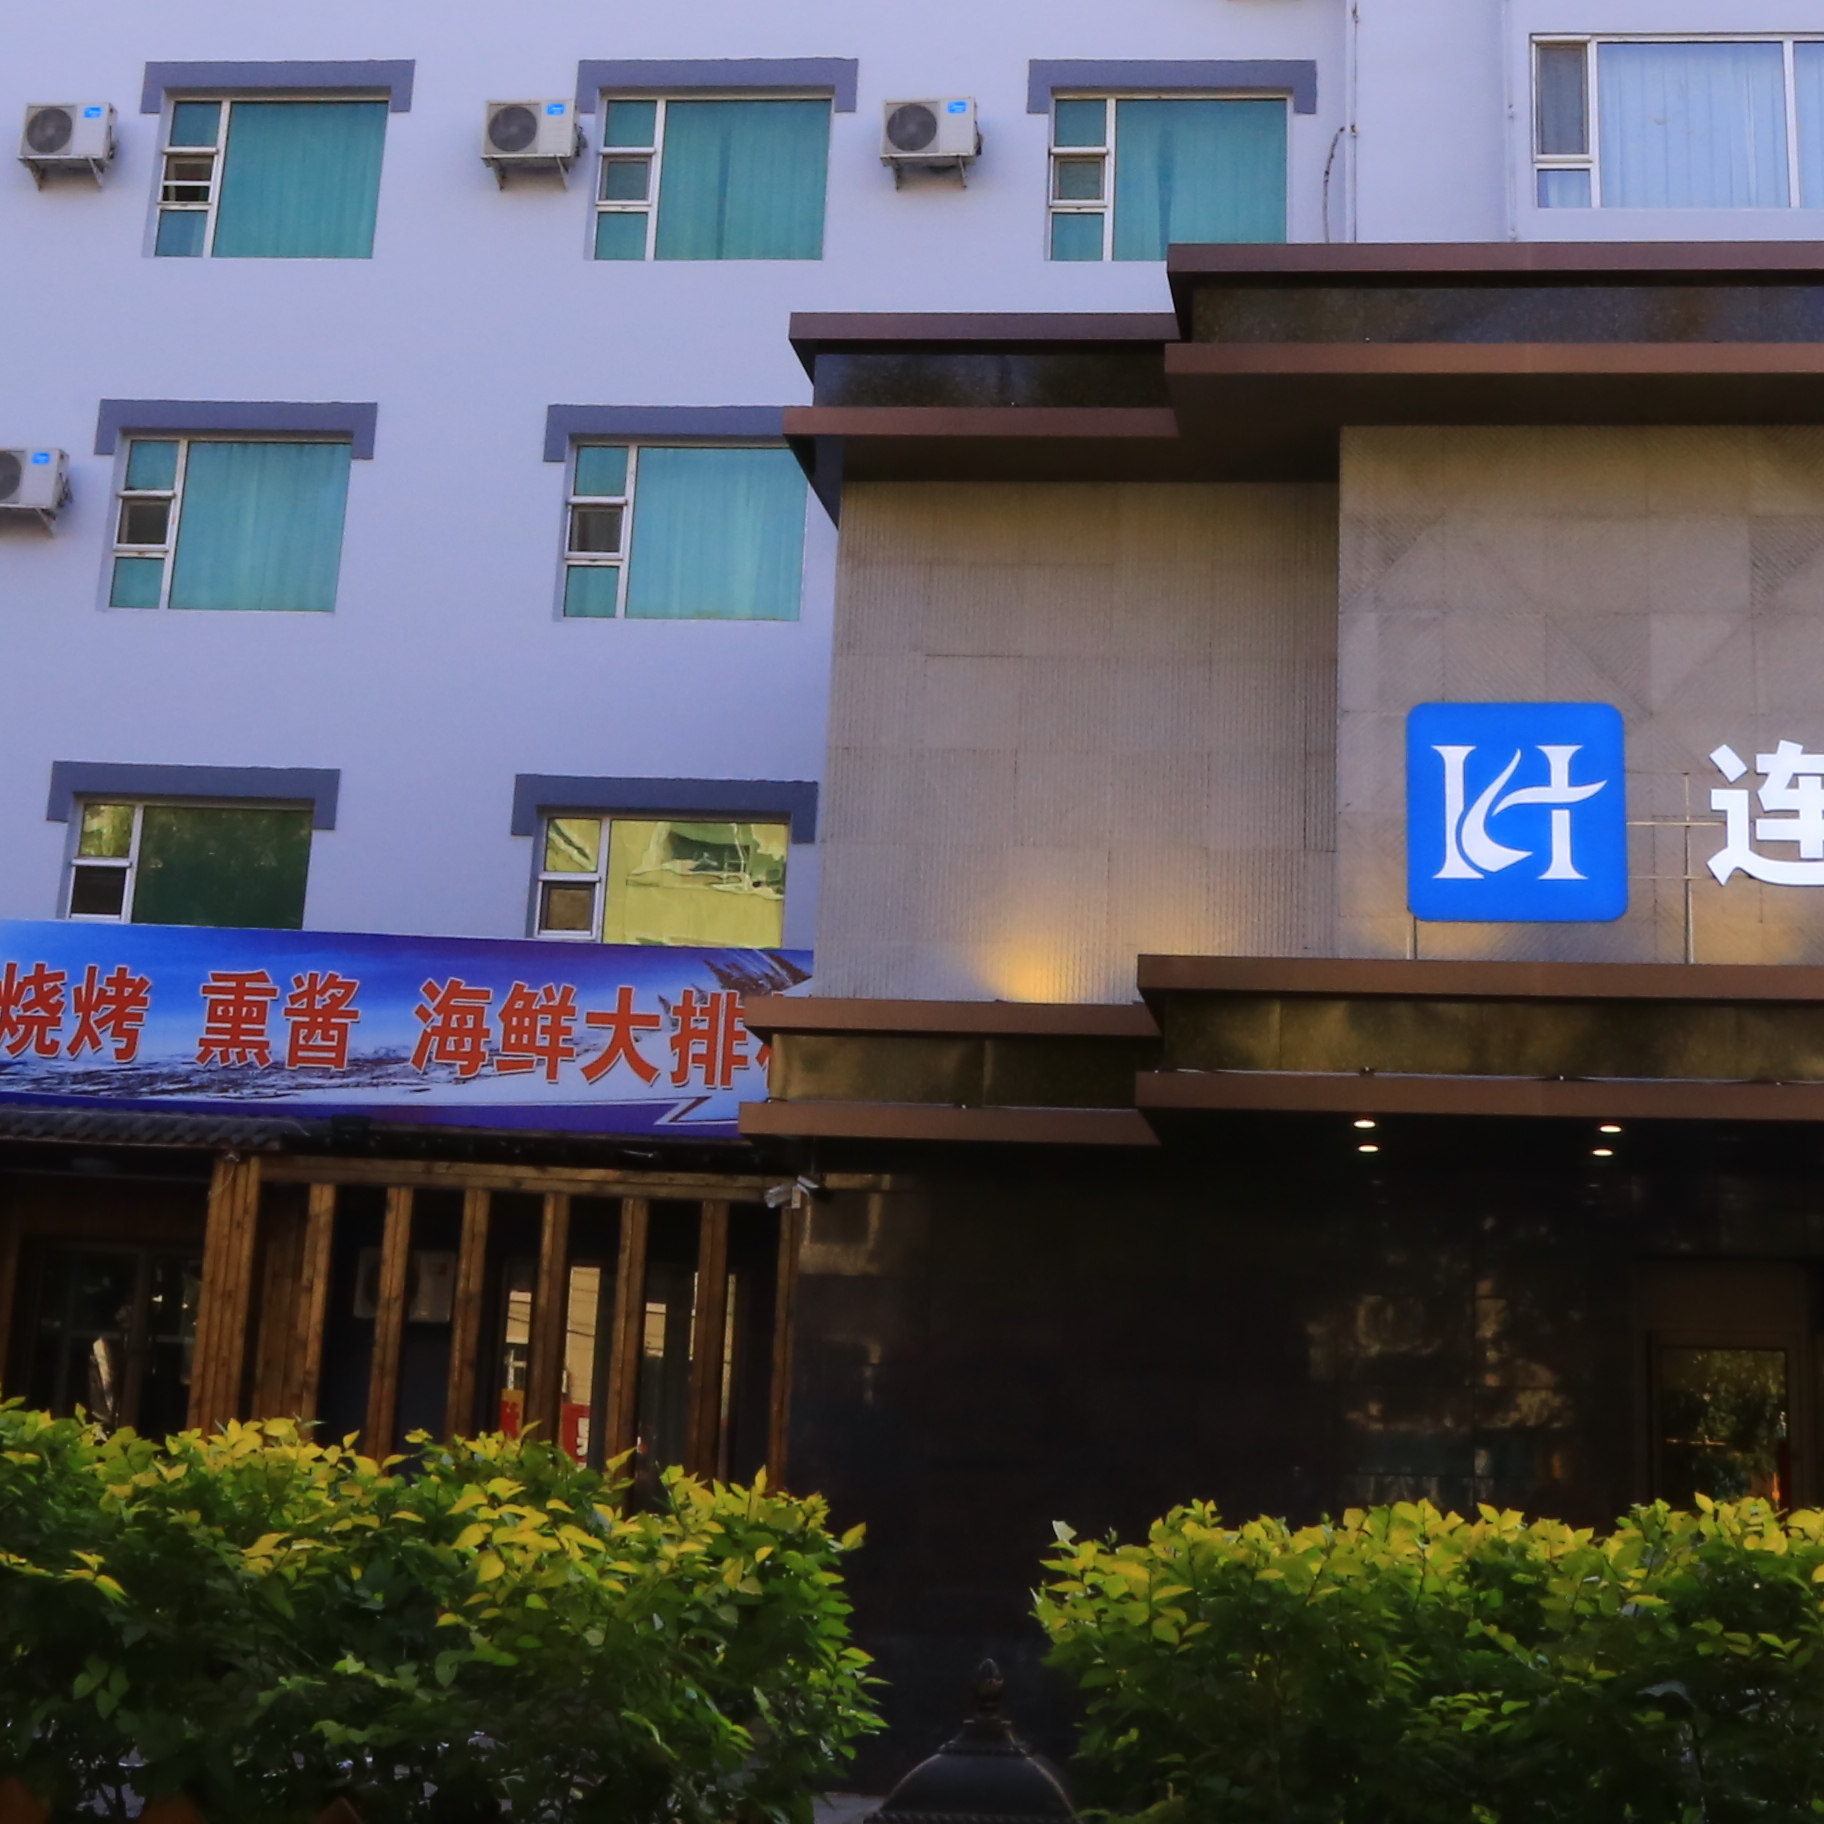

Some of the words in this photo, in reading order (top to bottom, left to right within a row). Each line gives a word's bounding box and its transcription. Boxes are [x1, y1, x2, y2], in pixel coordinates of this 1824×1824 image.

[194, 969, 360, 1071] 熏酱
[409, 977, 772, 1089] 海鲜大排
